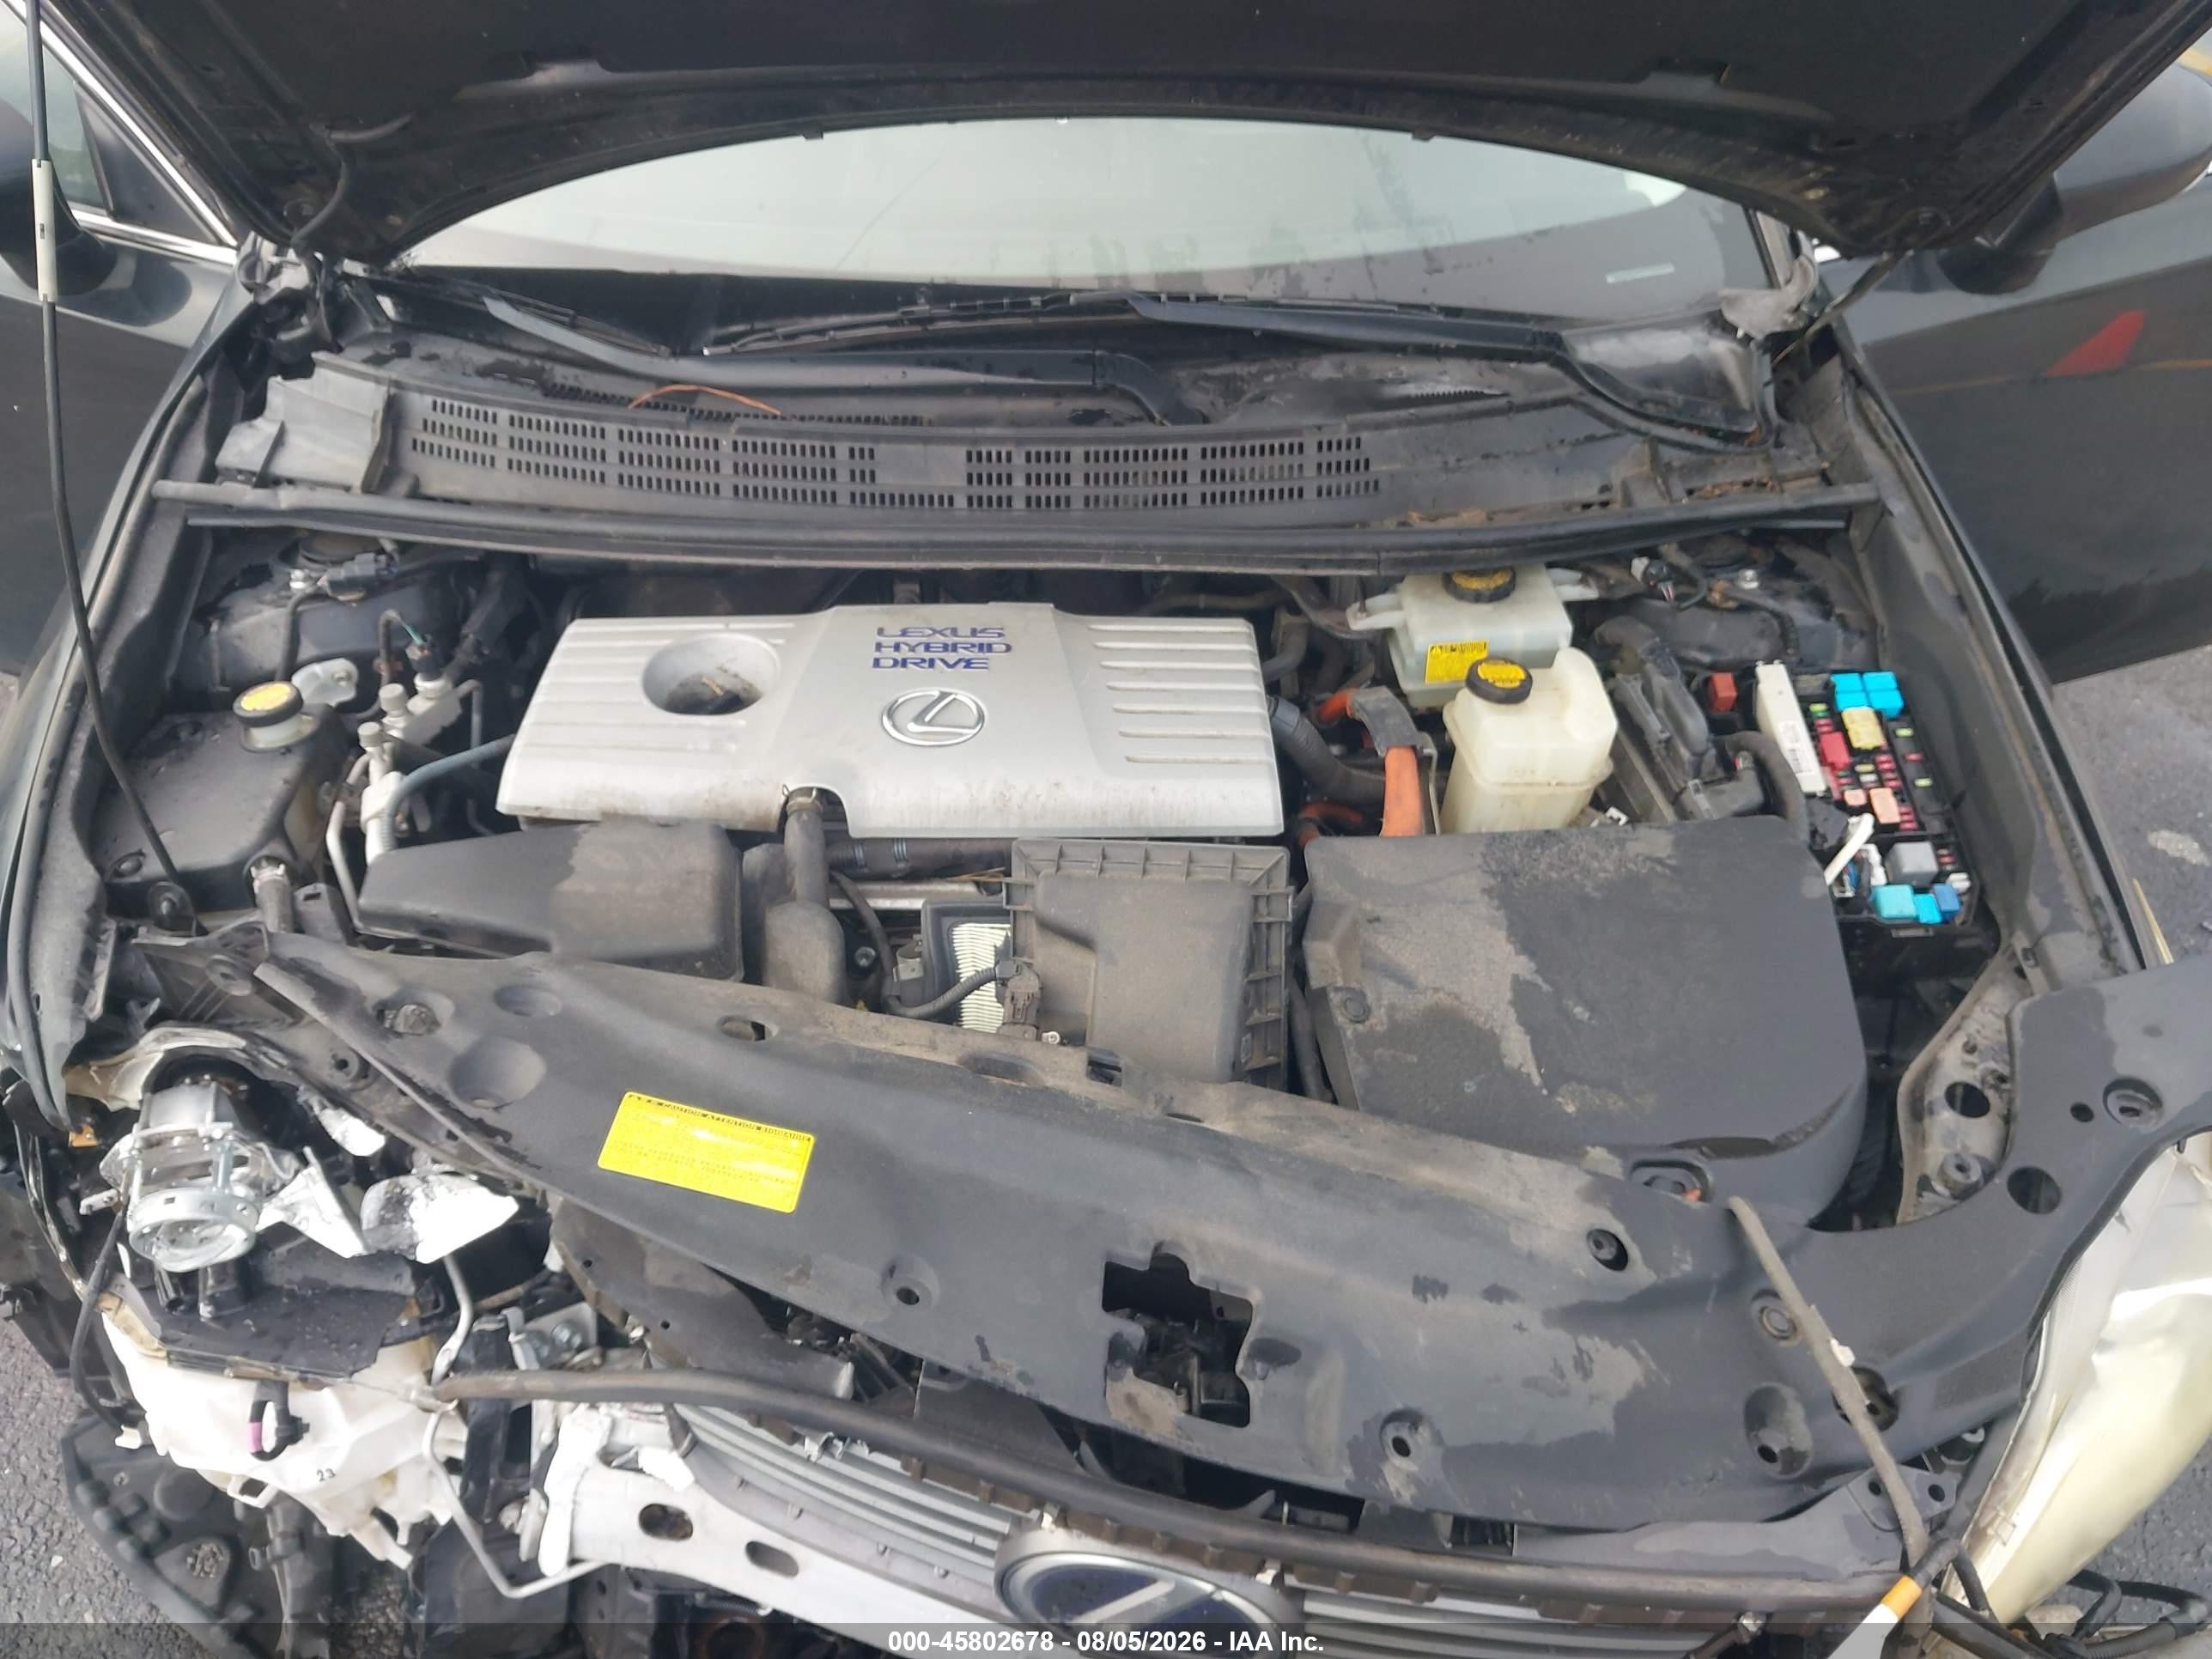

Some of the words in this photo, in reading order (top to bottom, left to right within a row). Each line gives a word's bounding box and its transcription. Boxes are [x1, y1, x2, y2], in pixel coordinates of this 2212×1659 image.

[877, 627, 1005, 638] LEXUS
[874, 641, 1012, 653] HYBRID
[872, 658, 989, 669] DRIVE
